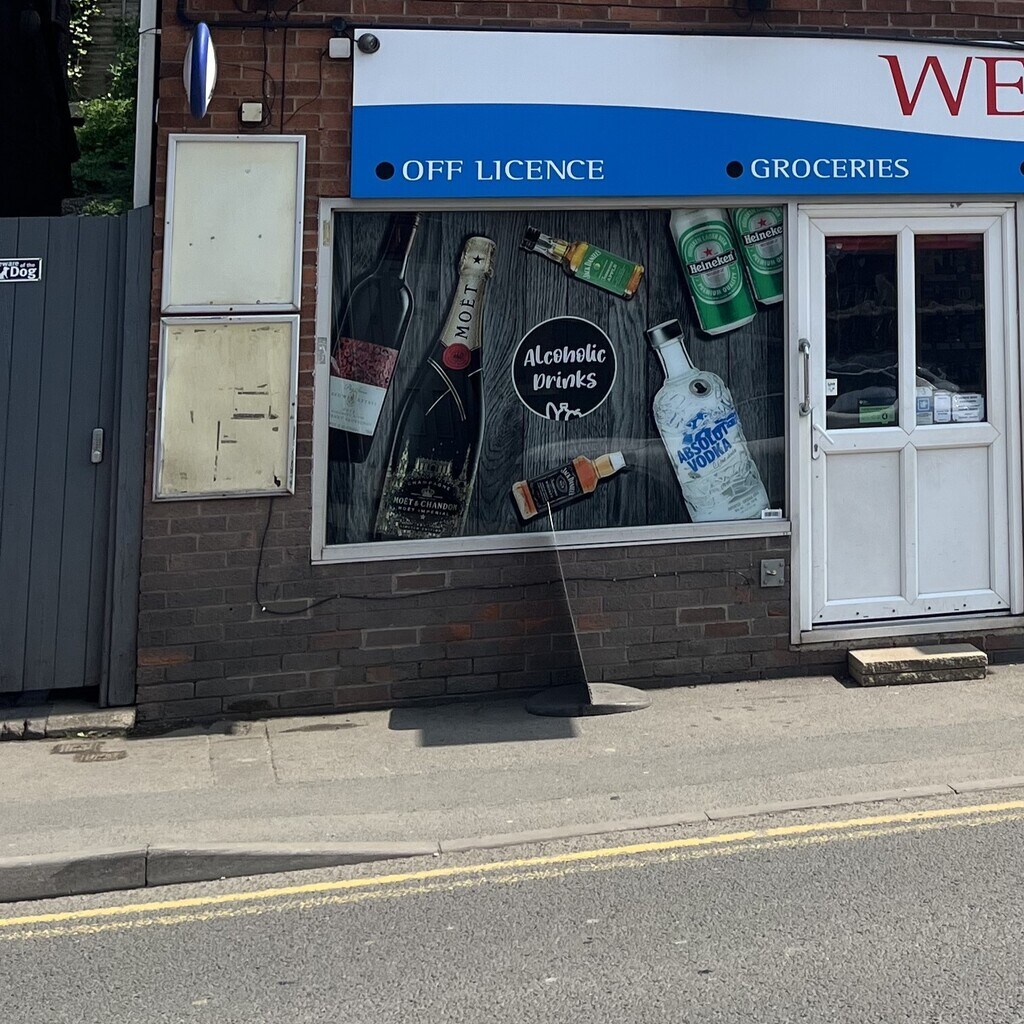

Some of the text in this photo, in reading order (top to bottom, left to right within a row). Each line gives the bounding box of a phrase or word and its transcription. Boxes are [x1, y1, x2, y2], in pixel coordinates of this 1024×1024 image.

[402, 159, 605, 181] OFF LICENCE
[751, 158, 910, 179] GROCERIES
[10, 266, 37, 280] Dog
[689, 252, 735, 274] Heineken
[523, 343, 606, 367] Alcoholic
[533, 370, 597, 391] Drinks
[686, 438, 732, 473] VODKA
[420, 500, 458, 511] CHANDON
